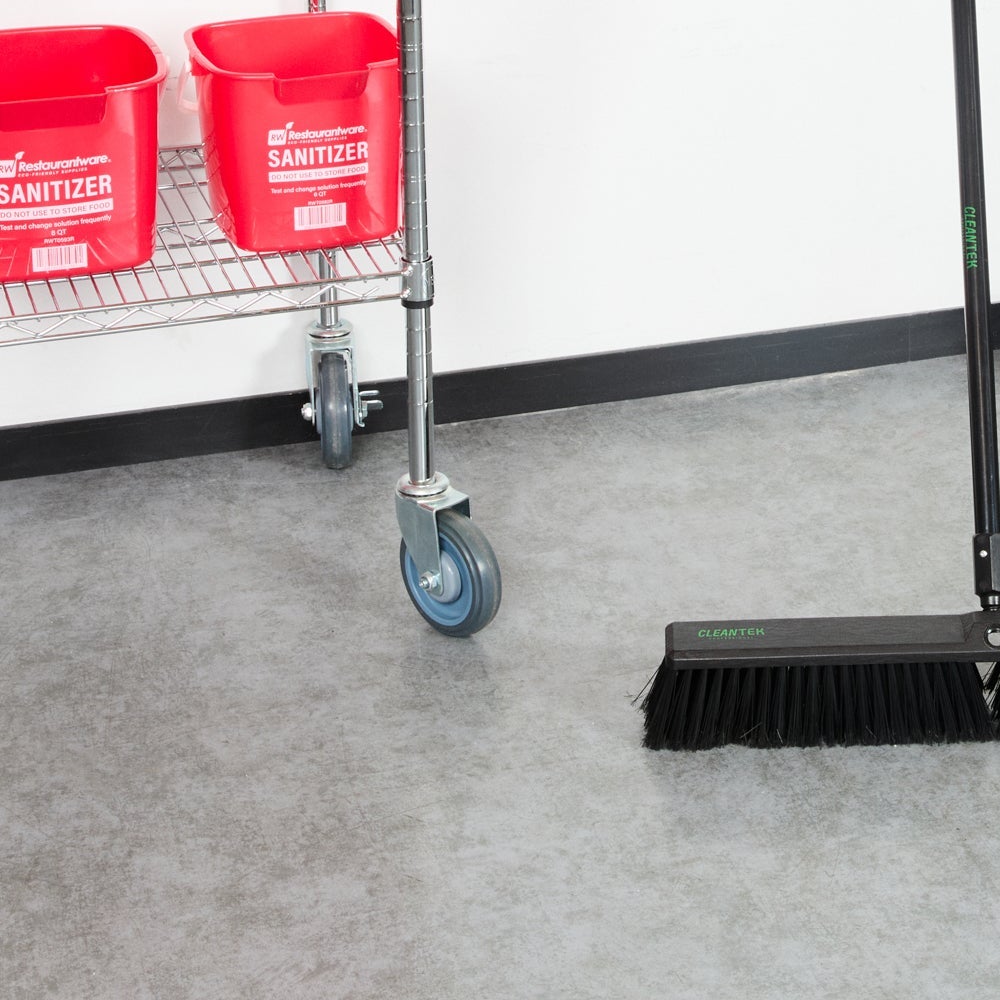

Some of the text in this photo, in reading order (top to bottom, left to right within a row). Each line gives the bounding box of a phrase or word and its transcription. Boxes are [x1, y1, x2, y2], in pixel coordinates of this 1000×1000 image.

[268, 141, 369, 168] SANITIZER
[325, 168, 346, 176] STORE
[347, 165, 366, 174] FOOD
[0, 174, 112, 205] SANITIZER
[295, 185, 316, 193] change
[317, 182, 339, 190] solution
[340, 179, 367, 188] frequently
[32, 209, 48, 217] USE
[62, 205, 87, 214] STORE
[89, 202, 110, 211] FOOD
[28, 221, 52, 230] change
[54, 218, 79, 228] solution
[80, 214, 112, 225] frequently
[56, 228, 67, 236] QT
[964, 206, 978, 269] CLEANTEK
[697, 627, 766, 638] CLEANTEK
